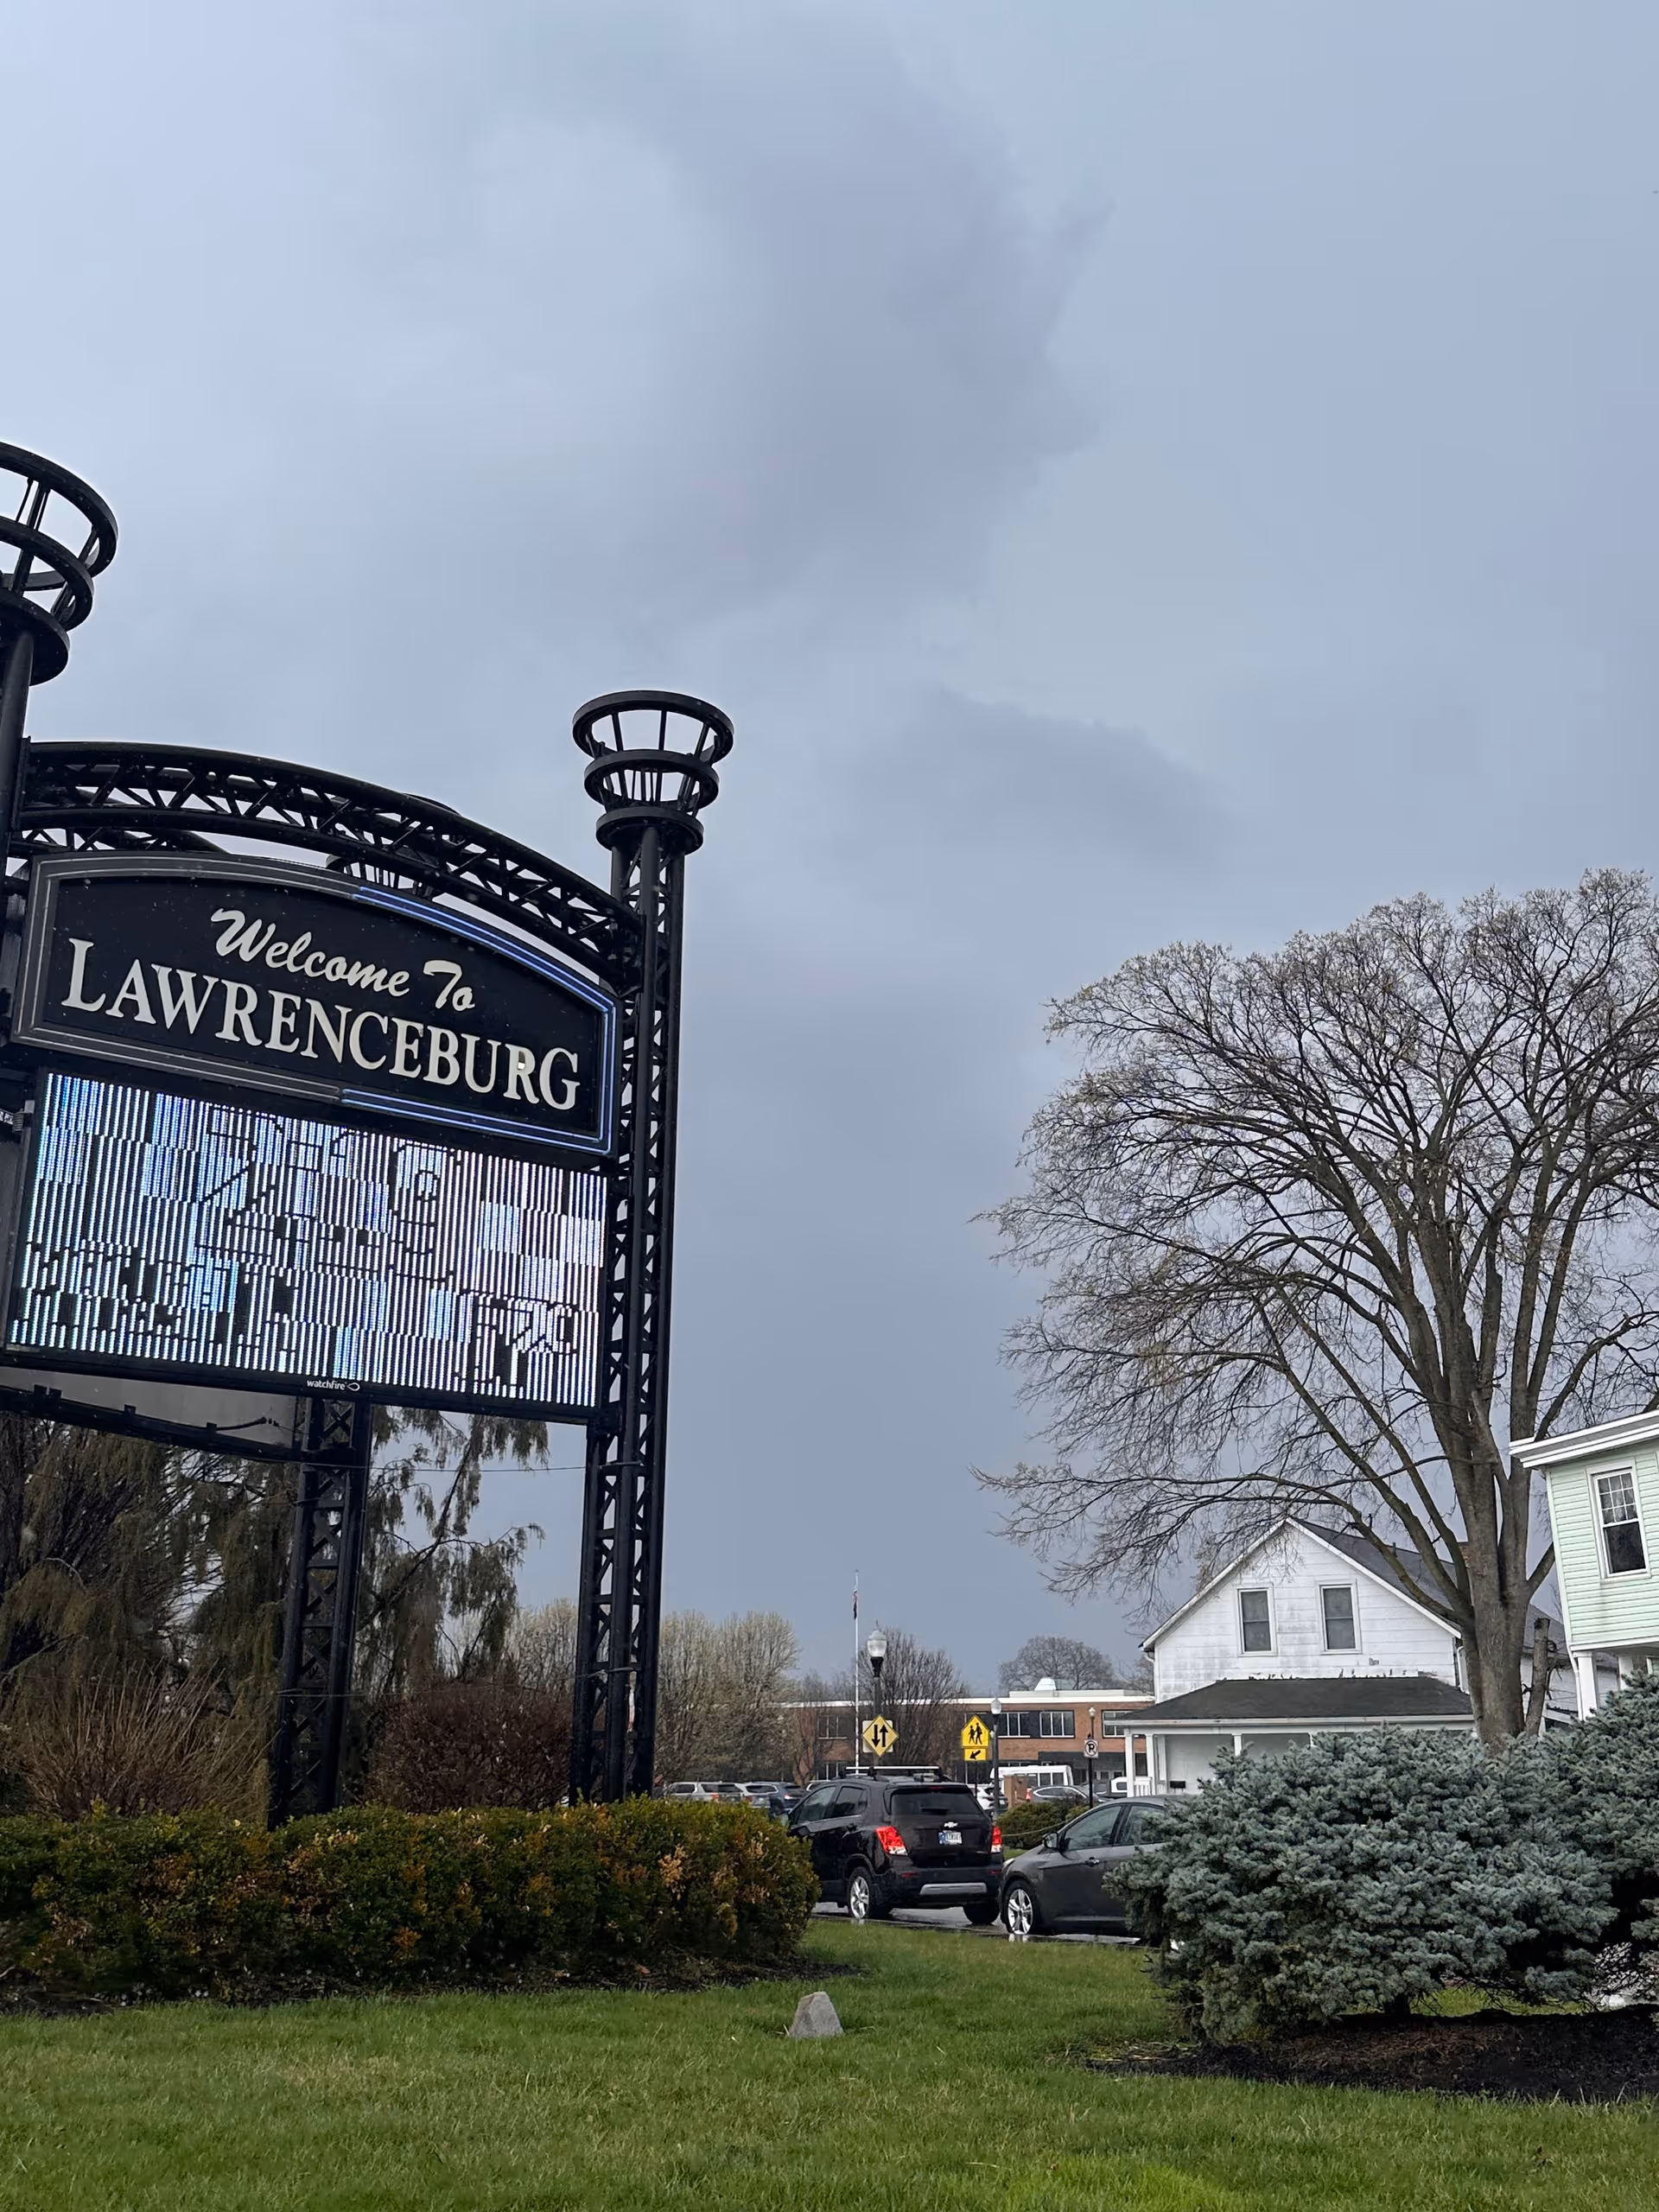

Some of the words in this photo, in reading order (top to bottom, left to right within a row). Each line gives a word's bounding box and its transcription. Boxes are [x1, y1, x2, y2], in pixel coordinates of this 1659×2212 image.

[211, 908, 410, 996] Welcome
[423, 959, 475, 1012] To
[61, 938, 580, 1111] LAWRENCEBURG
[307, 1380, 346, 1390] watchfire
